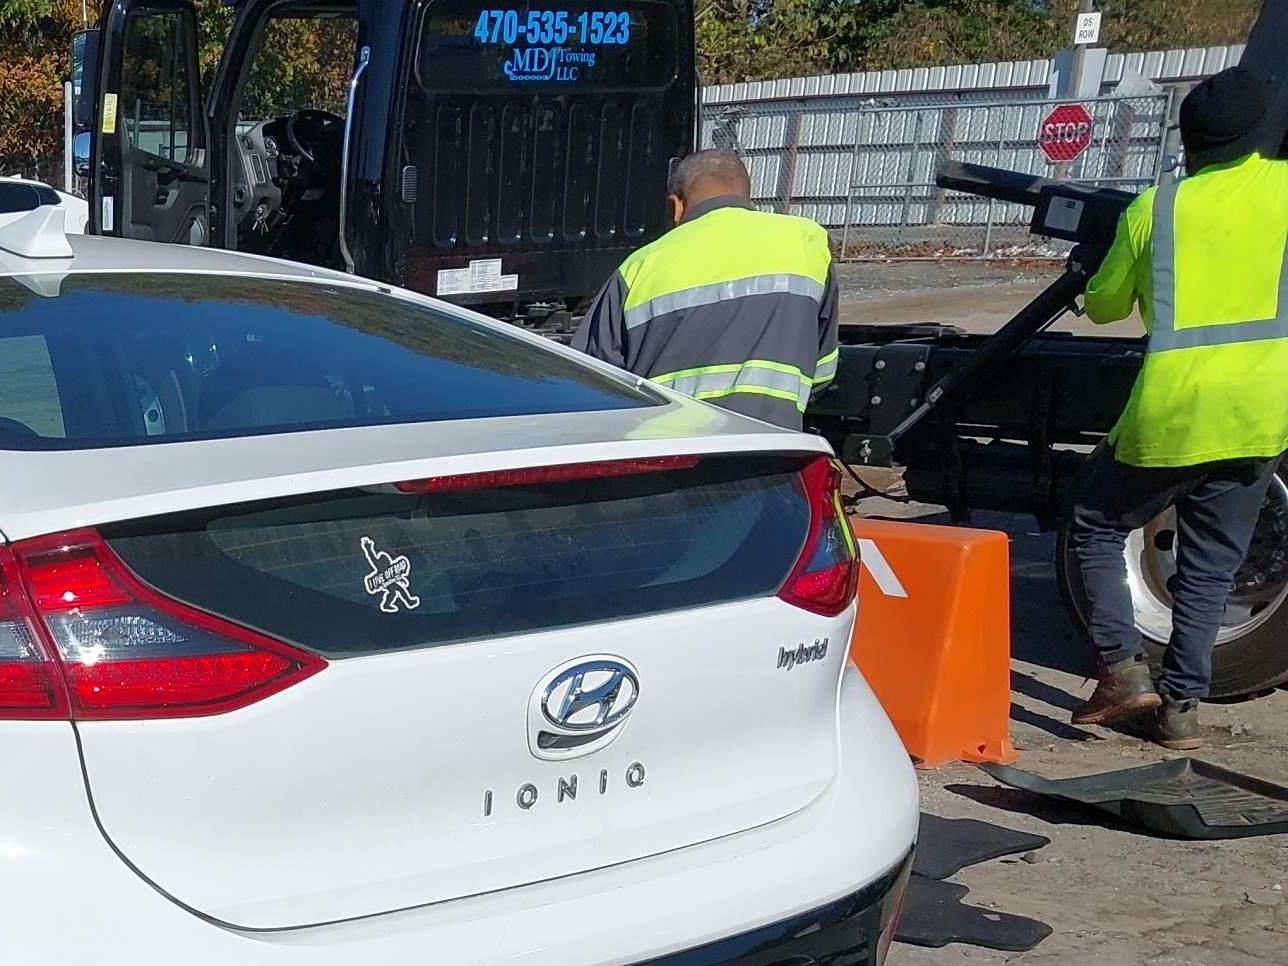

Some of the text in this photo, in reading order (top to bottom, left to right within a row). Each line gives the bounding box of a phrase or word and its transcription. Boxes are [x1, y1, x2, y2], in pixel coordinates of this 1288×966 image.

[474, 10, 630, 44] 470-535-1523
[1078, 29, 1095, 39] ROW
[559, 49, 595, 66] Towing
[556, 67, 578, 81] LLC
[1044, 122, 1089, 143] STOP
[777, 638, 829, 671] hybrid
[483, 761, 646, 817] IONIQ
